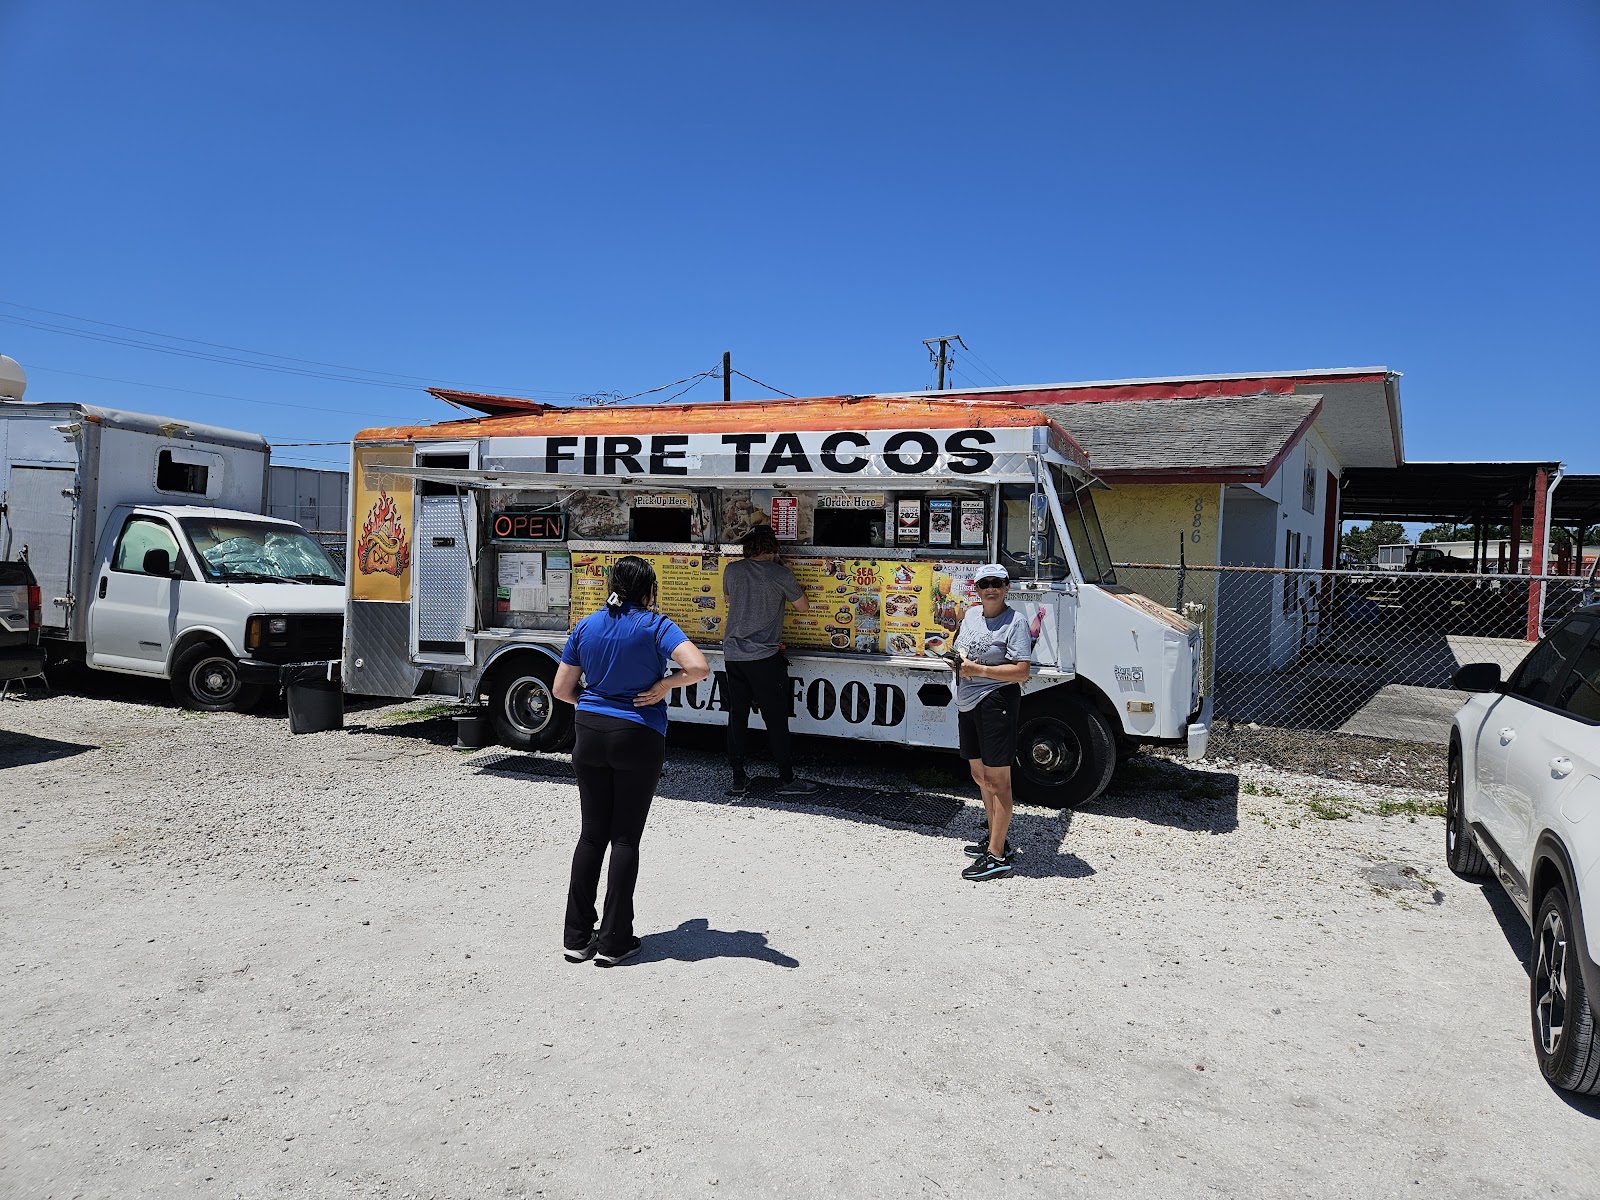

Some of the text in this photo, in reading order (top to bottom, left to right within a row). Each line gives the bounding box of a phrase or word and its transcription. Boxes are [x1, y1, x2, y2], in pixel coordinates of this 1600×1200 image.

[546, 429, 996, 475] FIRE TACOS
[637, 496, 688, 508] Pick Up Here
[825, 496, 876, 507] Order Here
[1191, 496, 1203, 543] 886
[495, 516, 561, 537] OPEN
[604, 555, 619, 565] Fir
[585, 564, 612, 577] MEN
[856, 567, 874, 577] SEA
[852, 575, 877, 586] FOOD
